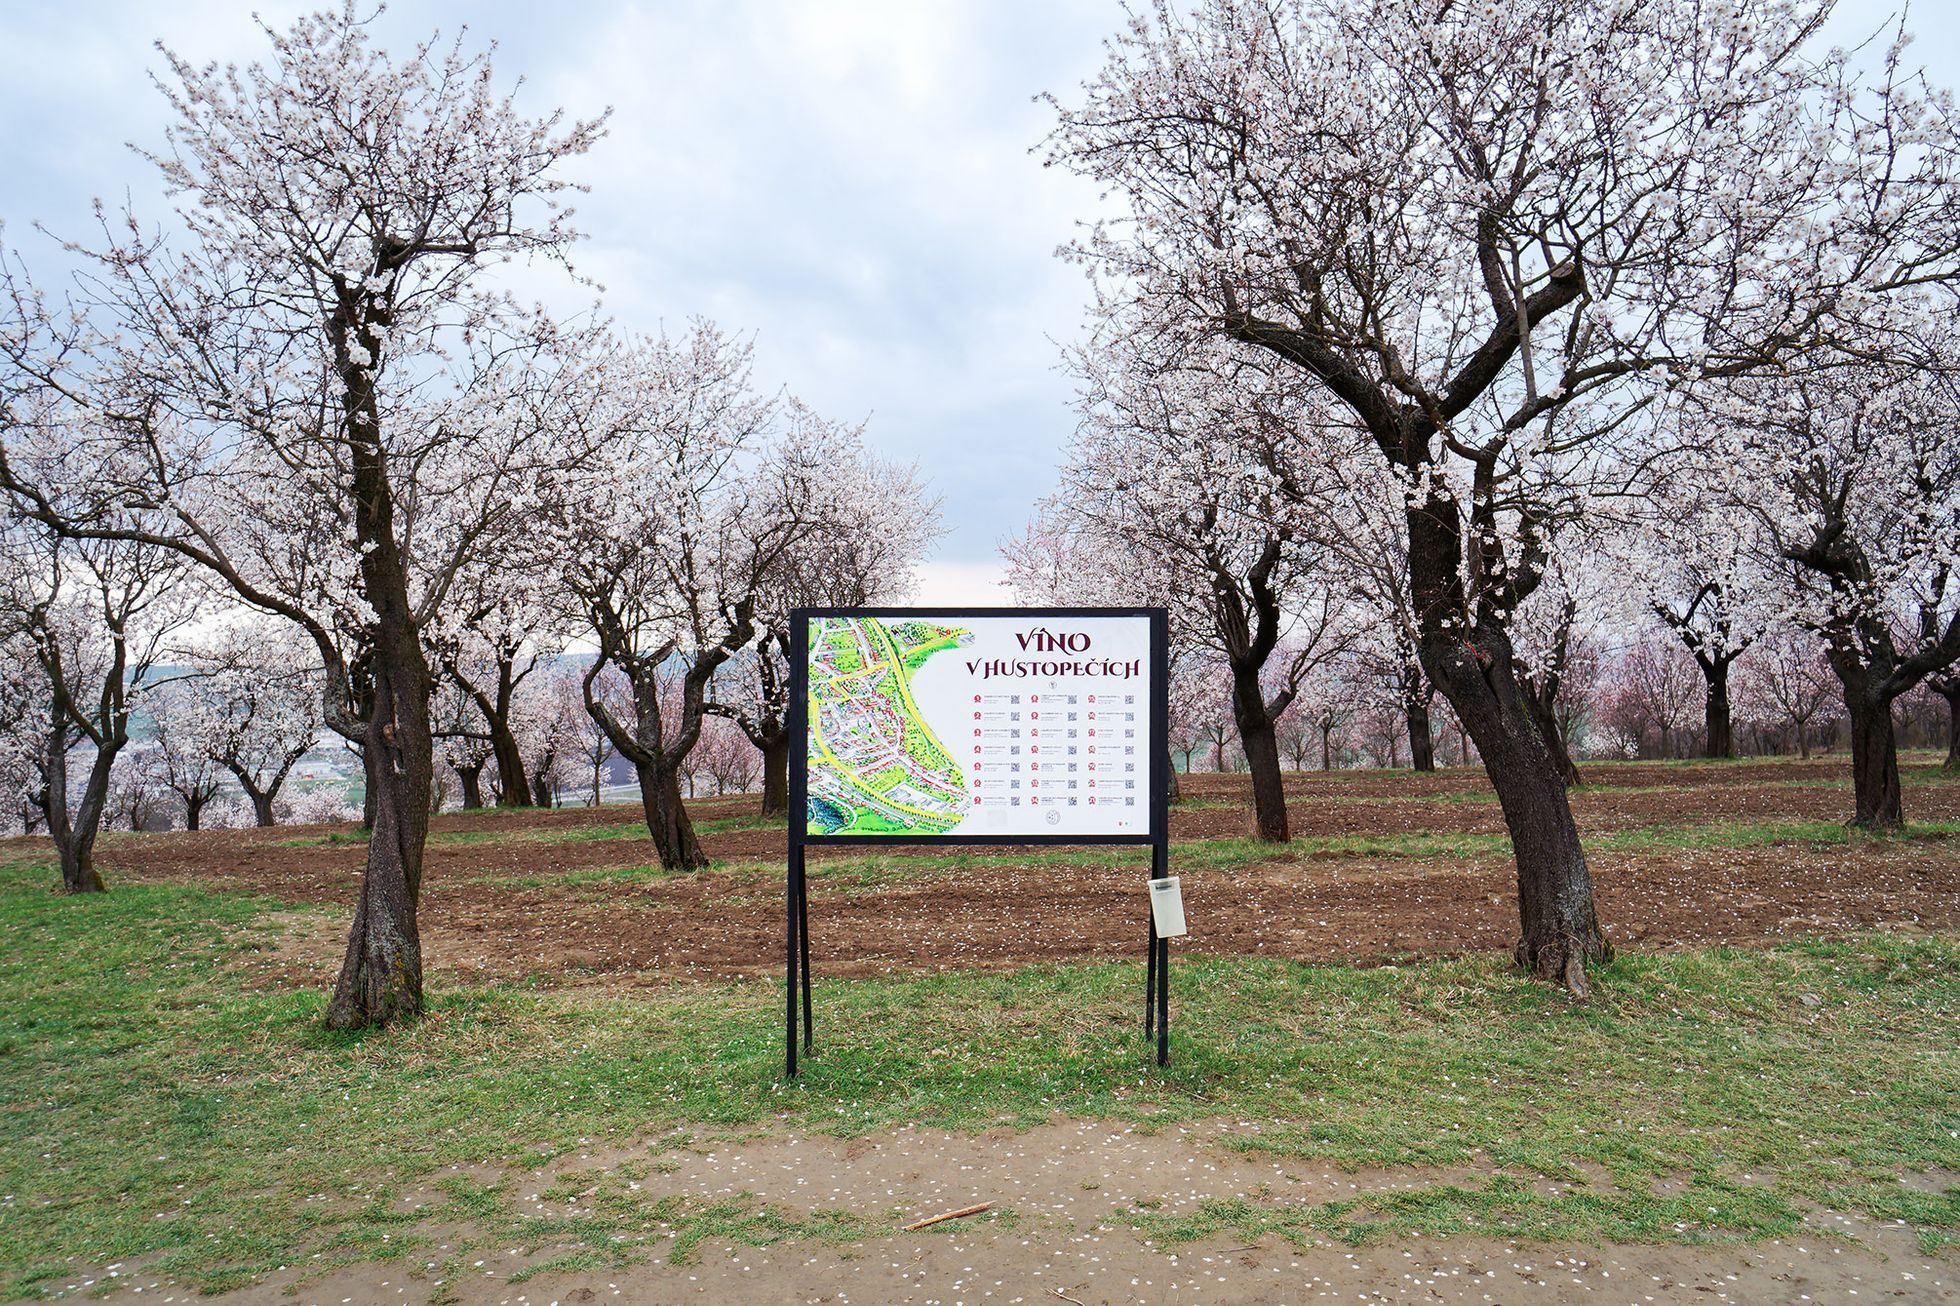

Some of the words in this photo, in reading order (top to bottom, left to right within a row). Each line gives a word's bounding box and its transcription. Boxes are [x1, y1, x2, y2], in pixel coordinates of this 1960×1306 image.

[1016, 627, 1091, 656] VÍNO
[966, 658, 983, 676] V
[983, 658, 1141, 680] HUSTOPEČÍCH
